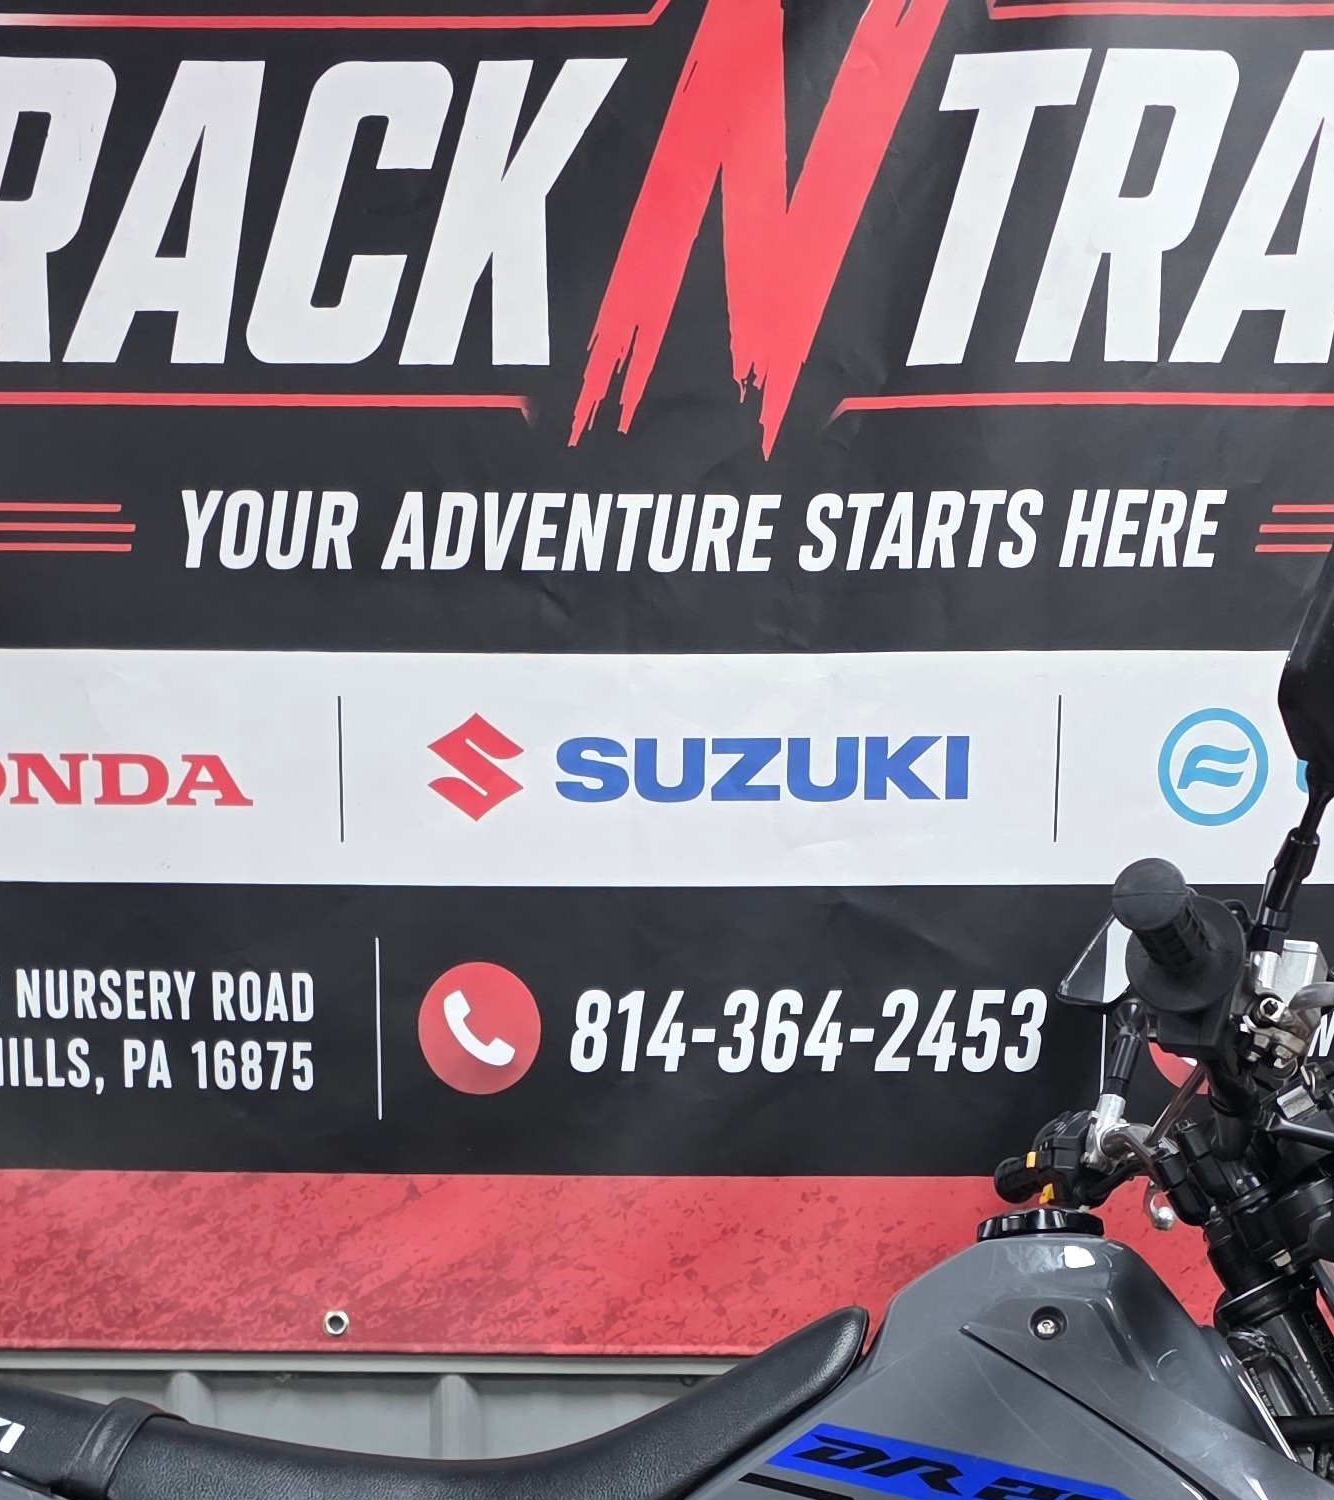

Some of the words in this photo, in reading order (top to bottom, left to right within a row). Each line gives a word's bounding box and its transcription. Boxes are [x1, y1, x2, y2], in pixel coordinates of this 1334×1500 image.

[567, 0, 951, 461] N
[180, 489, 359, 571] YOUR
[380, 490, 782, 573] ADVENTURE
[797, 488, 1046, 573] STARTS
[1057, 488, 1229, 569] HERE
[555, 734, 971, 803] SUZUKI
[15, 968, 197, 1022] NURSERY
[212, 970, 315, 1023] ROAD
[122, 1038, 173, 1089] PA
[190, 1040, 315, 1092] 16875
[569, 988, 1048, 1074] 814-364-2453
[791, 1432, 965, 1498] DR
